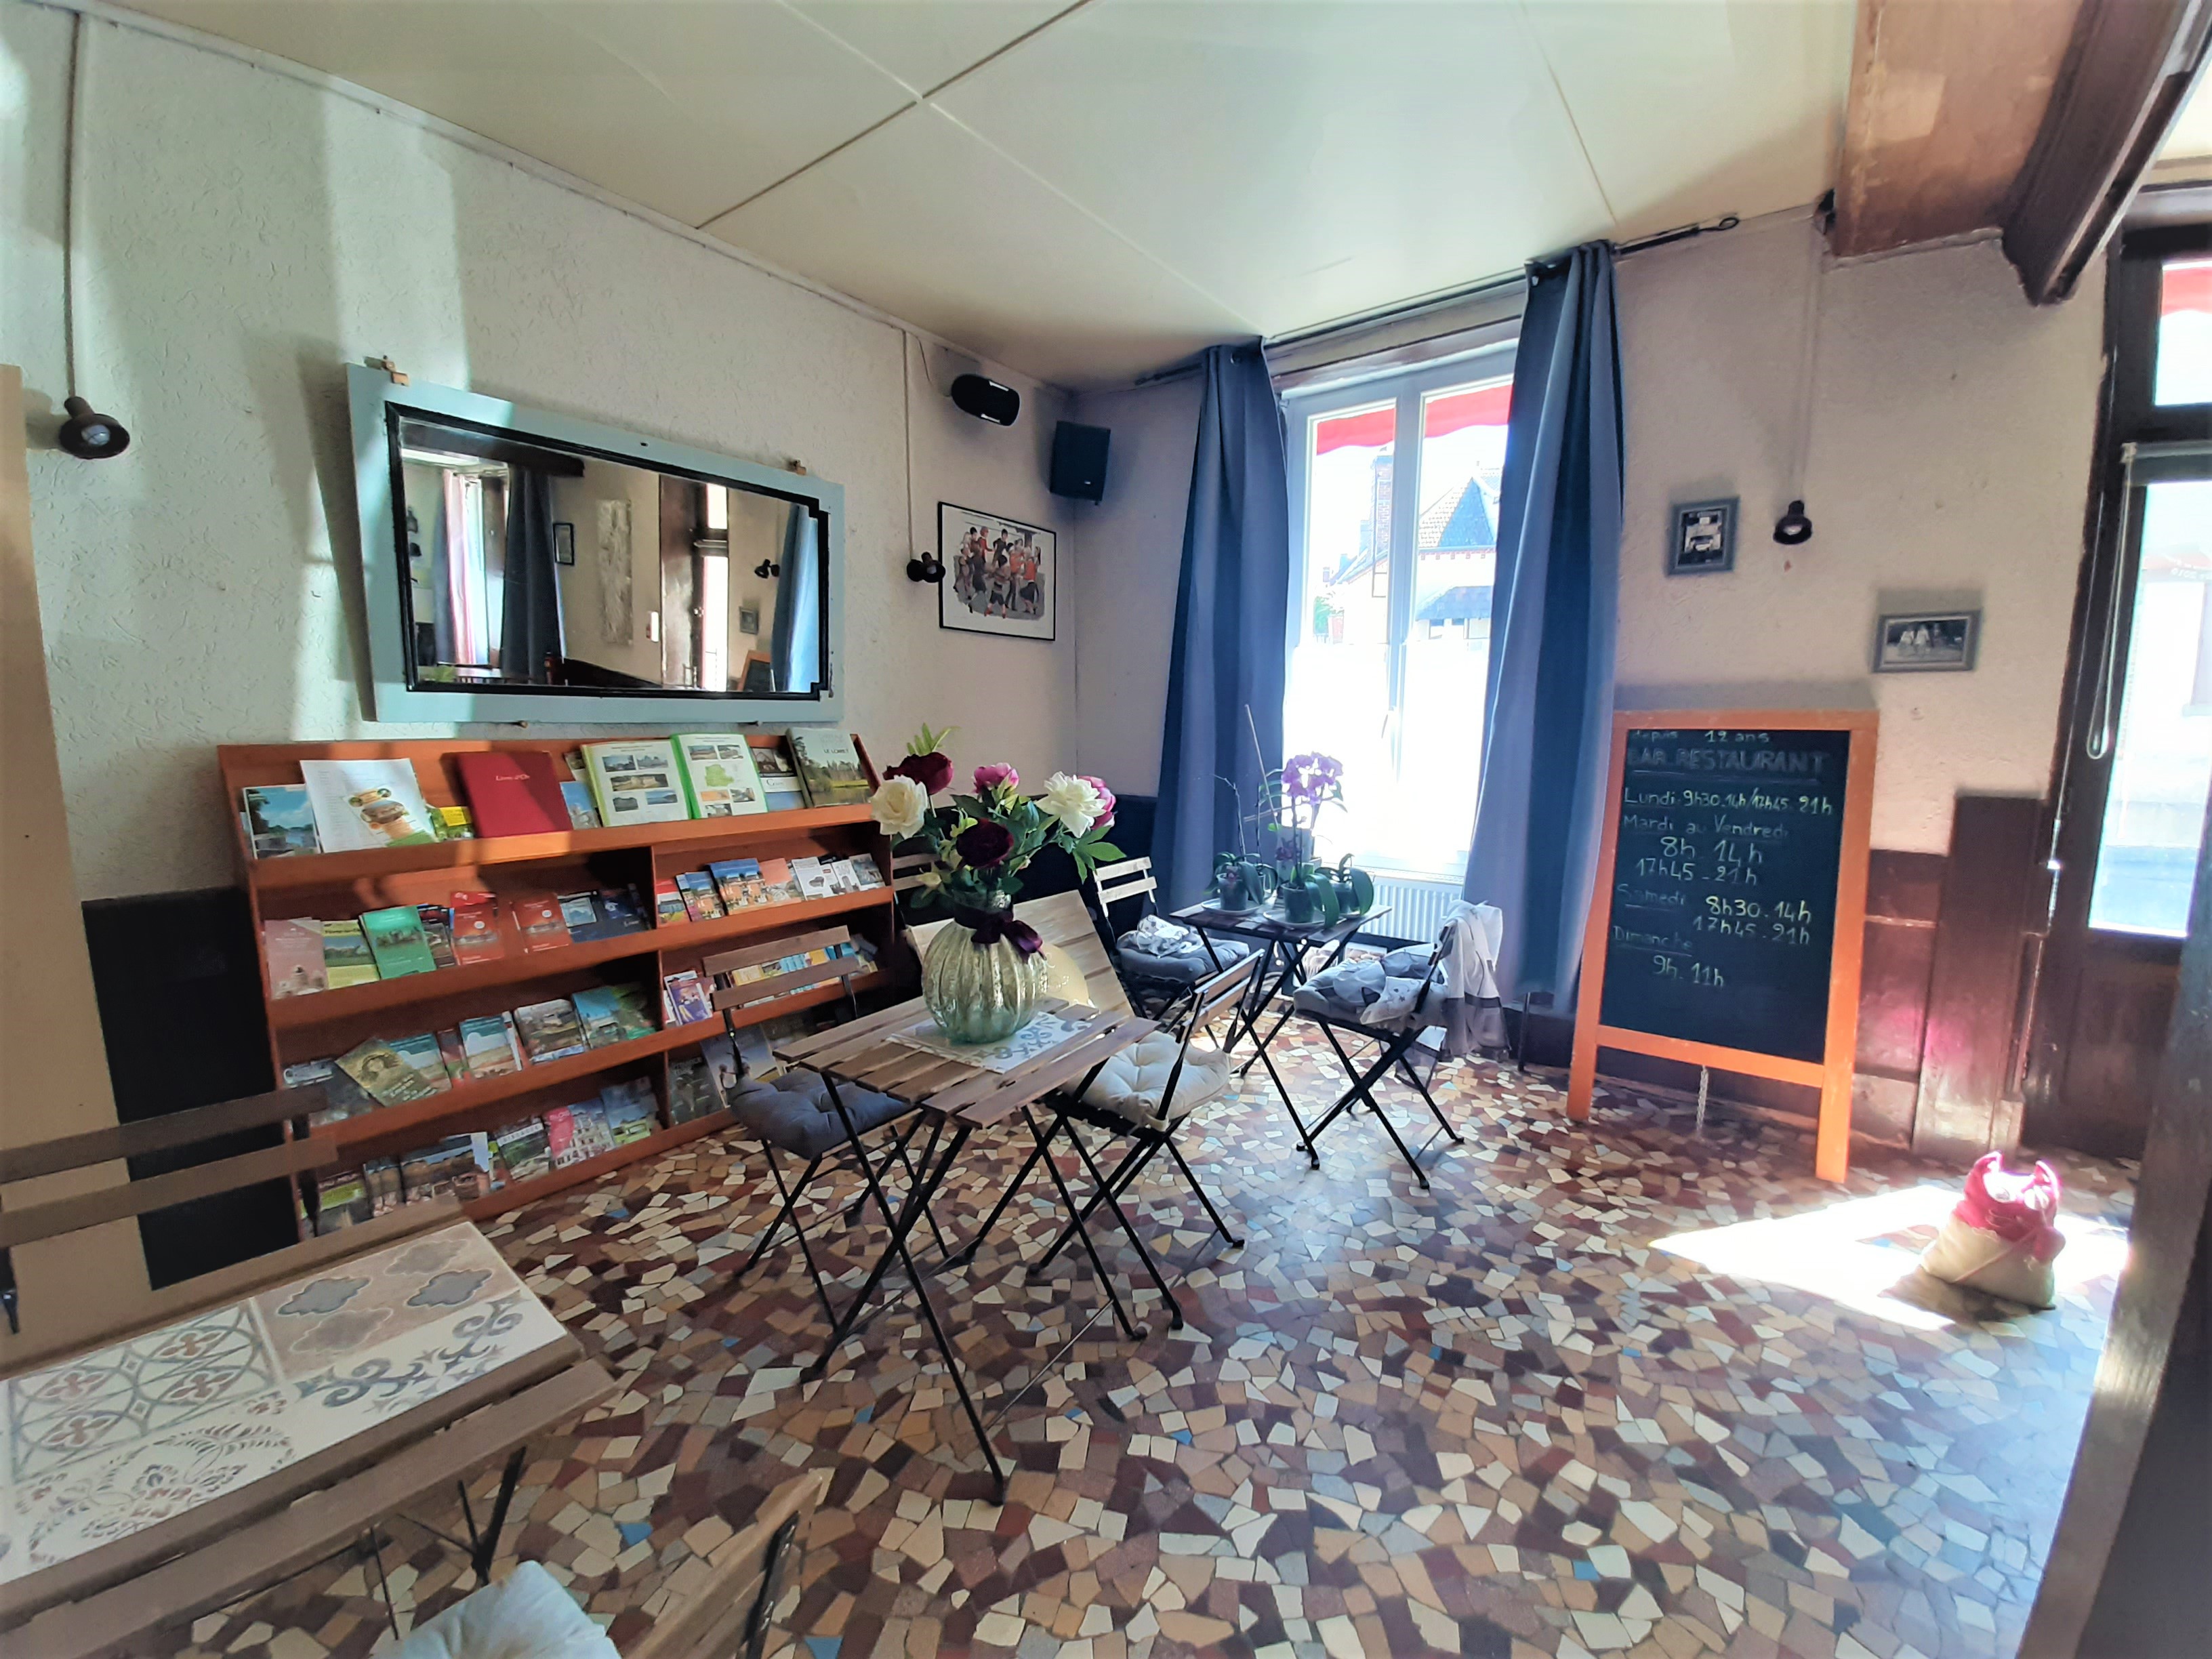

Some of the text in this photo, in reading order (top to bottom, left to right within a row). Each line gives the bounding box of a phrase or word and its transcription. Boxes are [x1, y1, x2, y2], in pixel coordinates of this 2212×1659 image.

[1735, 733, 1769, 743] ans
[1675, 747, 1828, 774] RESTAURANT
[1625, 787, 1675, 805] Lundi
[1624, 814, 1674, 831] Mardi
[1714, 814, 1788, 838] Vendredi
[1661, 836, 1695, 859] 8h
